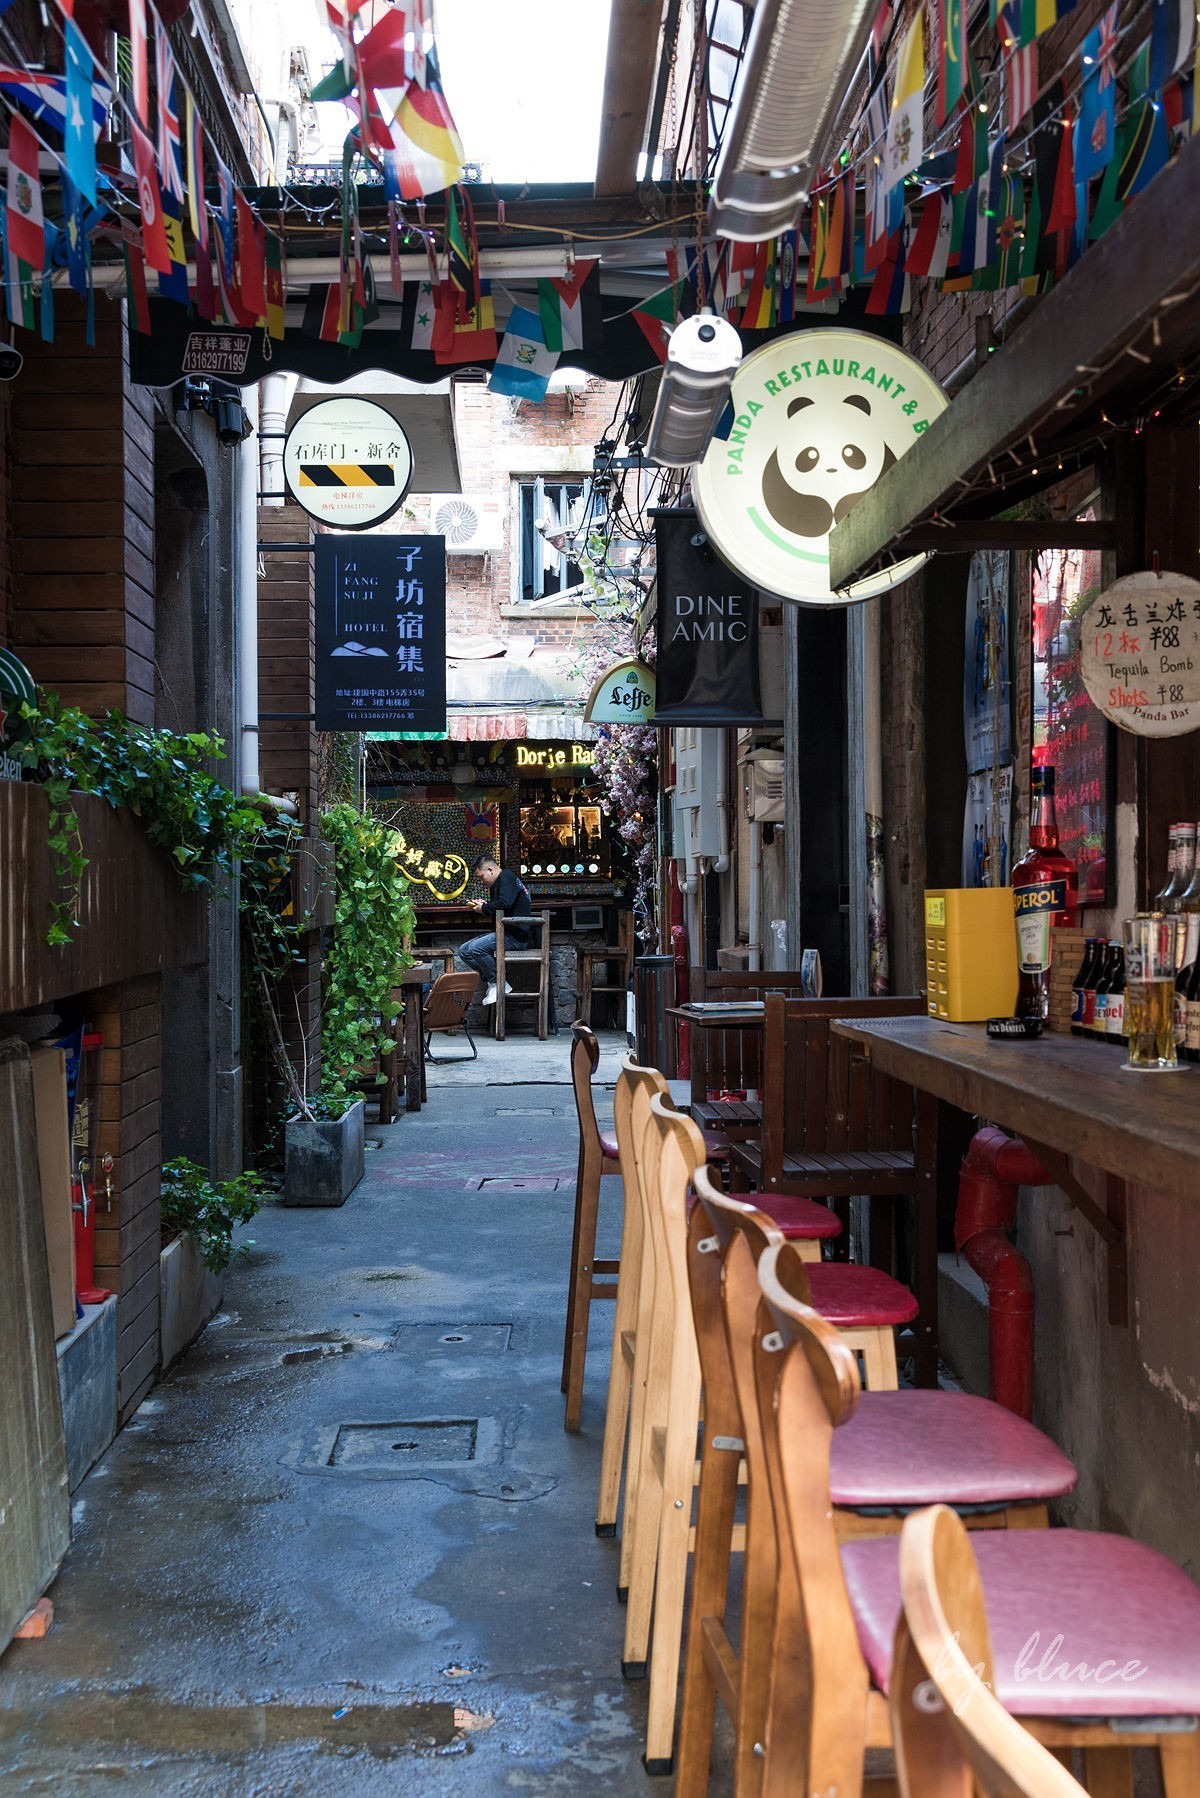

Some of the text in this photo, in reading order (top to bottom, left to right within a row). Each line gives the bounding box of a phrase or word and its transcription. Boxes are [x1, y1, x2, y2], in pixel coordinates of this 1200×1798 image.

[187, 352, 244, 371] 13162977199
[727, 358, 931, 475] PANDA RESTAURANT & B
[344, 563, 357, 571] ZI
[345, 577, 378, 585] FANG
[396, 546, 424, 672] 子坊宿集
[676, 595, 742, 616] DINE
[345, 624, 388, 632] HOTEL
[672, 621, 747, 642] AMIC
[1105, 660, 1149, 687] Tequila
[1160, 655, 1194, 674] Bomb
[609, 686, 653, 712] Leffe
[1108, 686, 1149, 706] Shots
[1133, 706, 1190, 721] Panda Bar
[517, 747, 566, 769] Dorje
